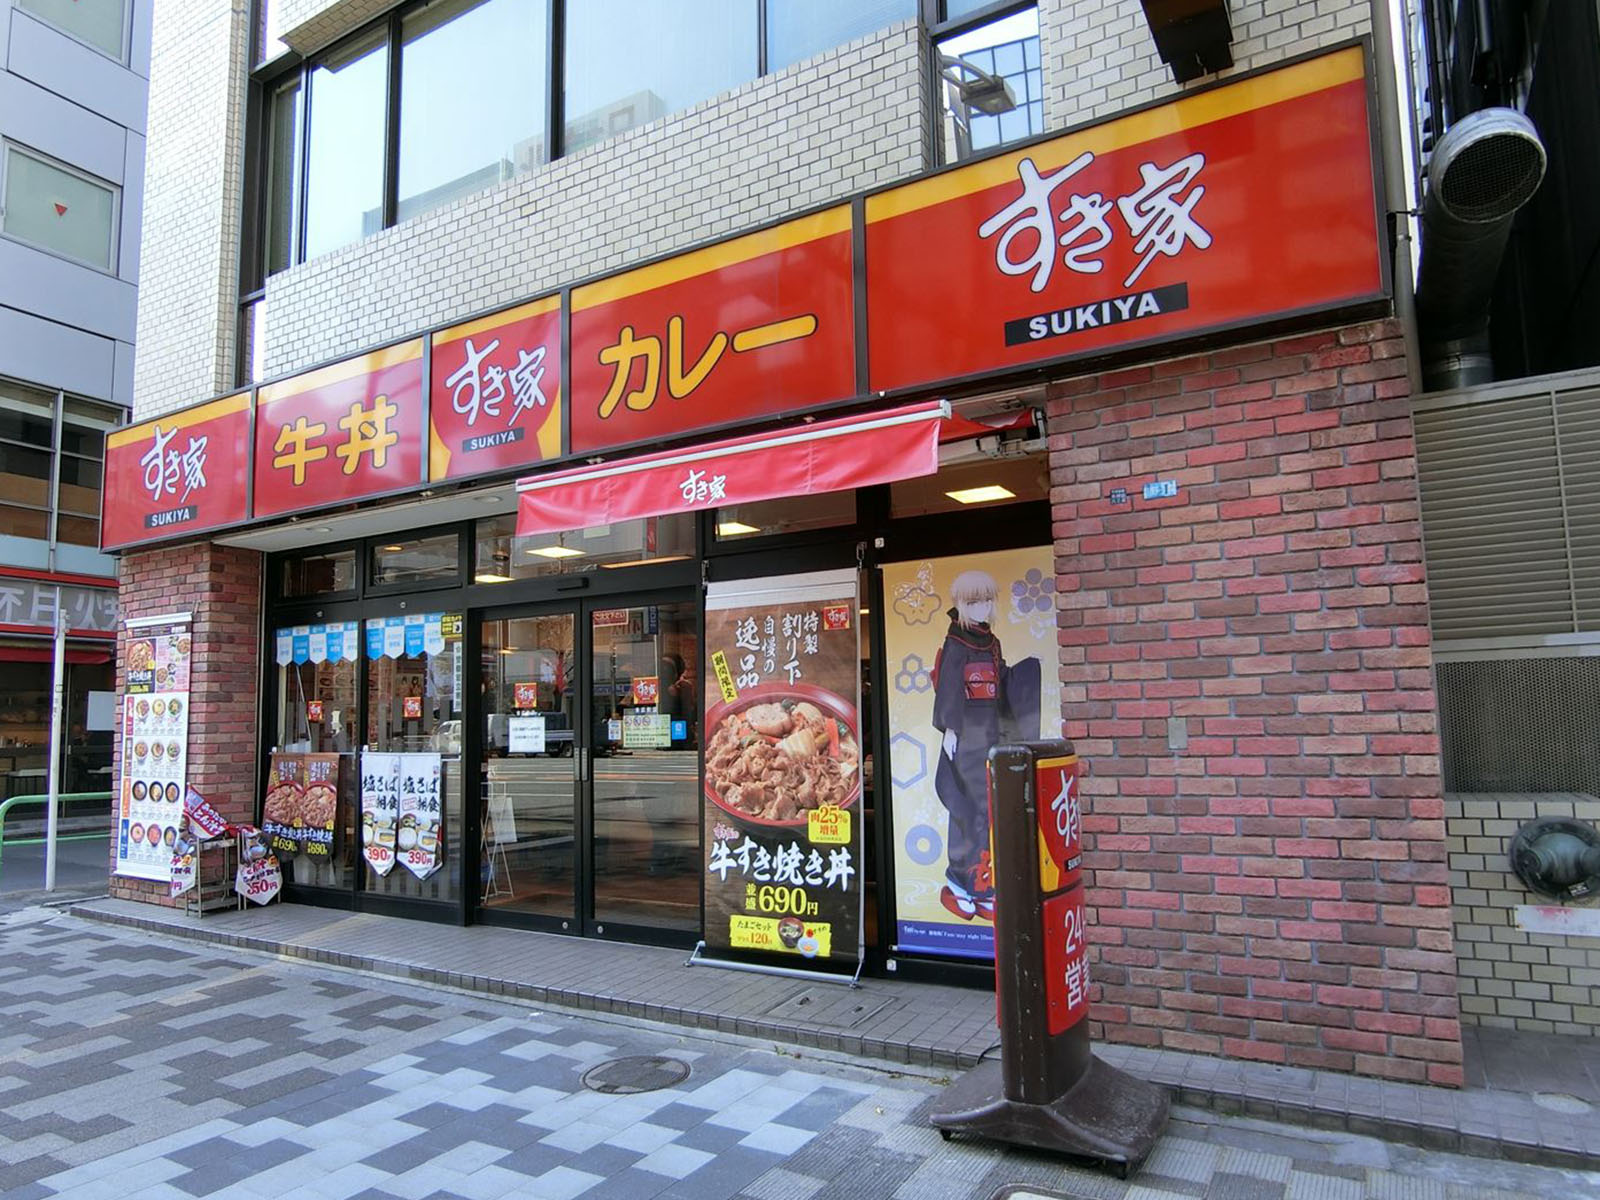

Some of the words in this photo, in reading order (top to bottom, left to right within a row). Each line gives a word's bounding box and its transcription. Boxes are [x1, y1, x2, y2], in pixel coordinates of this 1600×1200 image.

[978, 151, 1213, 292] すき家
[1028, 292, 1160, 339] SUKIYA
[445, 339, 547, 427] すき家
[599, 314, 818, 419] カレー
[140, 425, 209, 503] すき家
[273, 395, 398, 486] 牛丼
[470, 432, 516, 450] SUKIYA
[679, 469, 727, 505] すき家
[151, 508, 190, 527] SUKIYA
[736, 616, 761, 689] 逸品
[762, 615, 777, 674] 自慢の
[781, 612, 802, 686] 割り下
[803, 610, 819, 655] 特製
[403, 775, 439, 794] 塩さば
[708, 835, 856, 892] 牛すき焼き丼
[737, 920, 772, 931] たまごセット
[745, 883, 757, 911] 並盛
[758, 885, 819, 916] 690円
